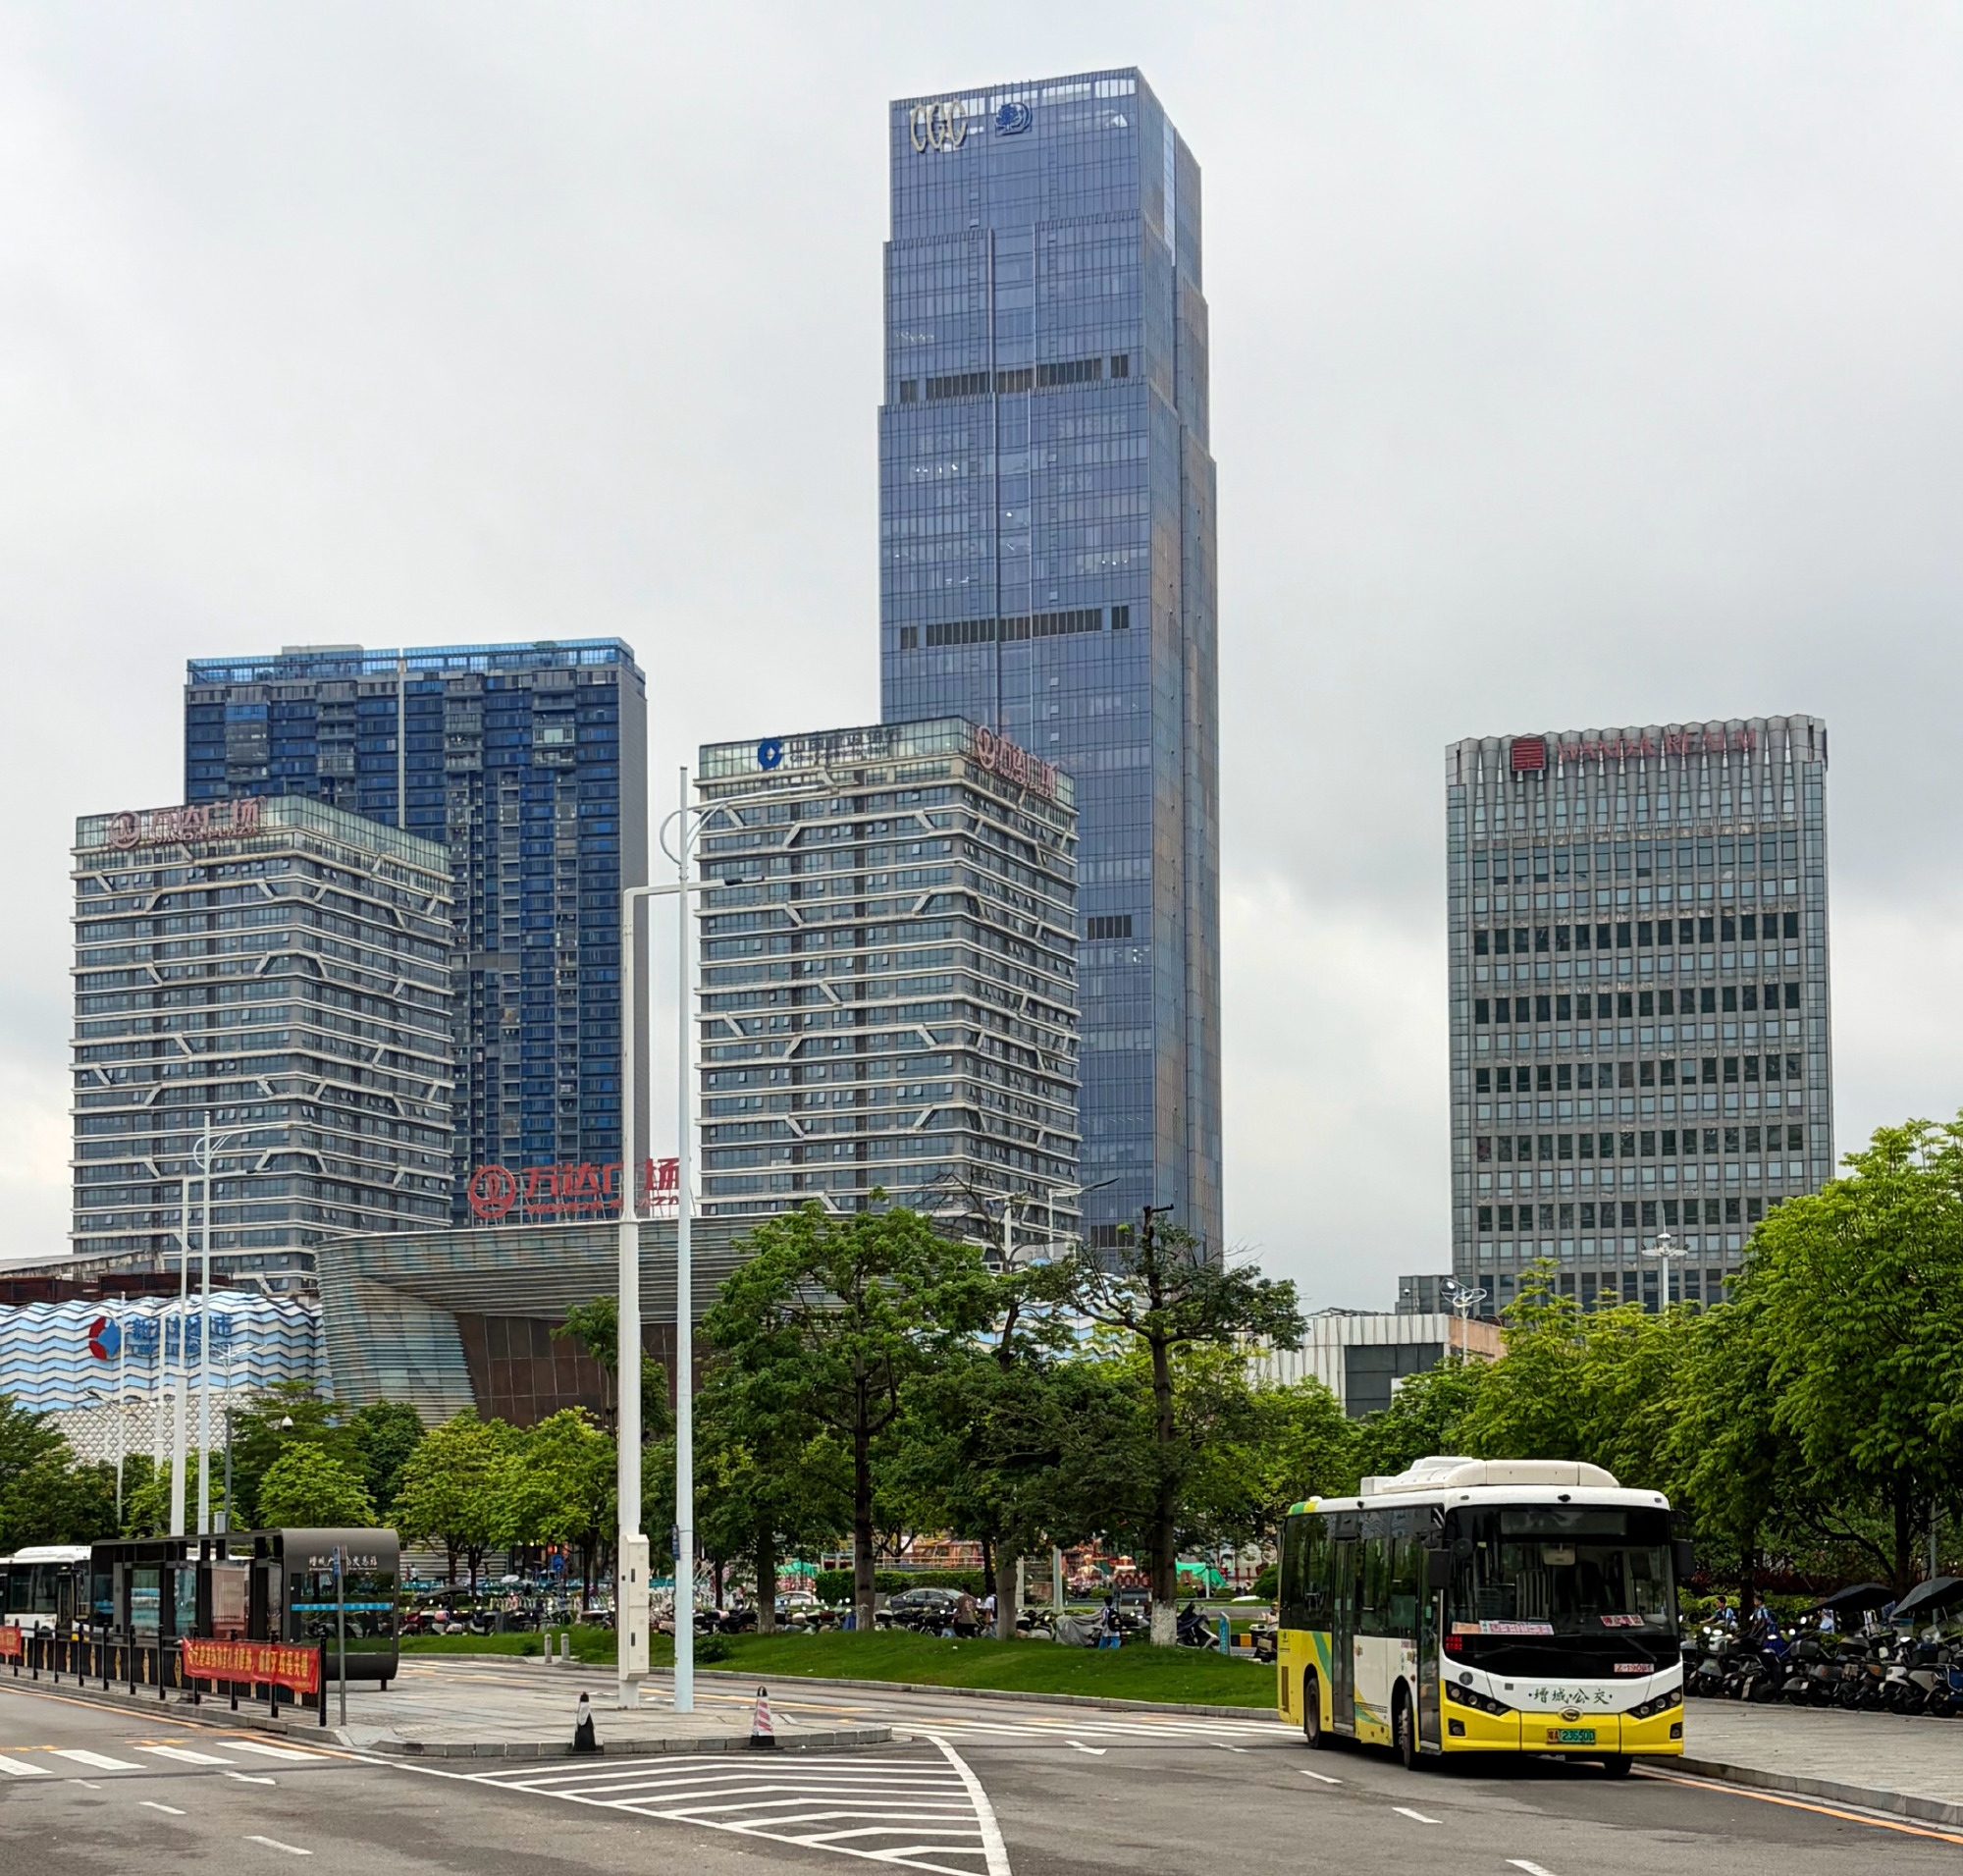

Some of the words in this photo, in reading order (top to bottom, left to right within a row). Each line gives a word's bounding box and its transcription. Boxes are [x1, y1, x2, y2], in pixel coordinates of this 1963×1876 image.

[1556, 735, 1655, 762] WANDA
[152, 798, 258, 832] 万达广场
